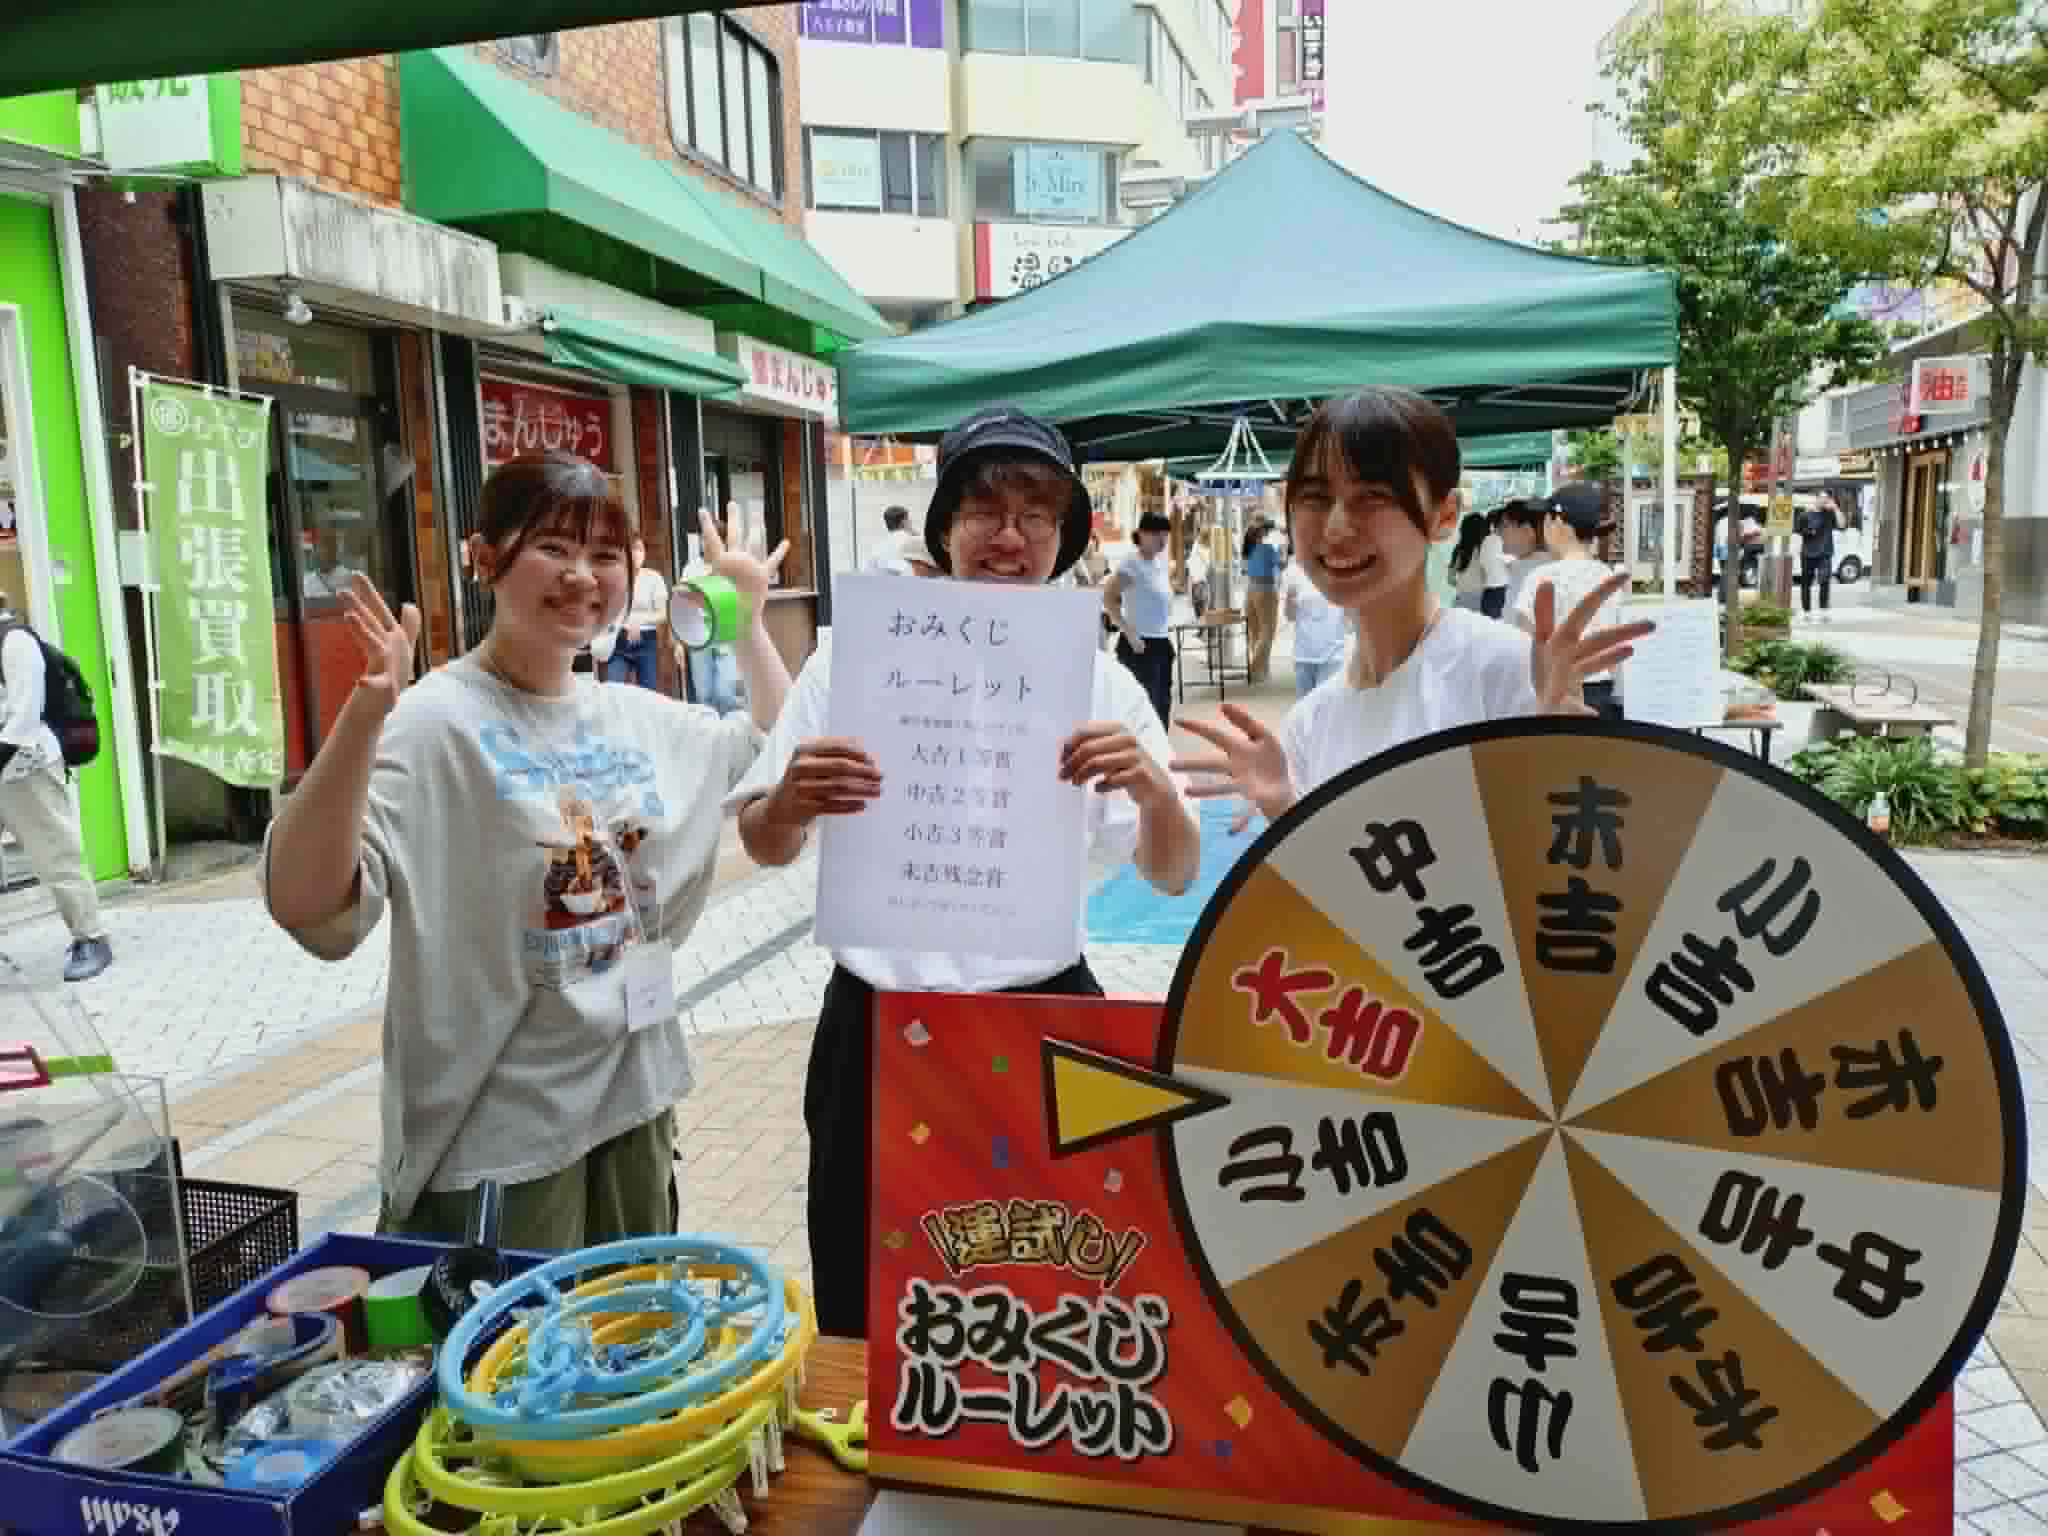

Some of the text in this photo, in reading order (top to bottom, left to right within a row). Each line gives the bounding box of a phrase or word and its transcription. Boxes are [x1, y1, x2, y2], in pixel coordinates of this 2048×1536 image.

[176, 447, 258, 738] 出張買取
[887, 608, 1010, 647] おみくじ
[884, 669, 1032, 703] ルーレット
[1348, 818, 1505, 999] 中吉
[1536, 776, 1633, 975] 末吉
[1645, 857, 1822, 1037] 小吉
[1230, 946, 1423, 1083] 大吉
[1715, 1028, 1944, 1137] 末吉
[1218, 1111, 1409, 1203] 小吉
[1306, 1208, 1473, 1377] 末吉
[1698, 1170, 1925, 1320] 中吉
[897, 1279, 1171, 1384] おみくじ
[1488, 1272, 1580, 1473] 小吉
[1611, 1253, 1779, 1451] 末吉
[893, 1360, 1173, 1460] ルーレット
